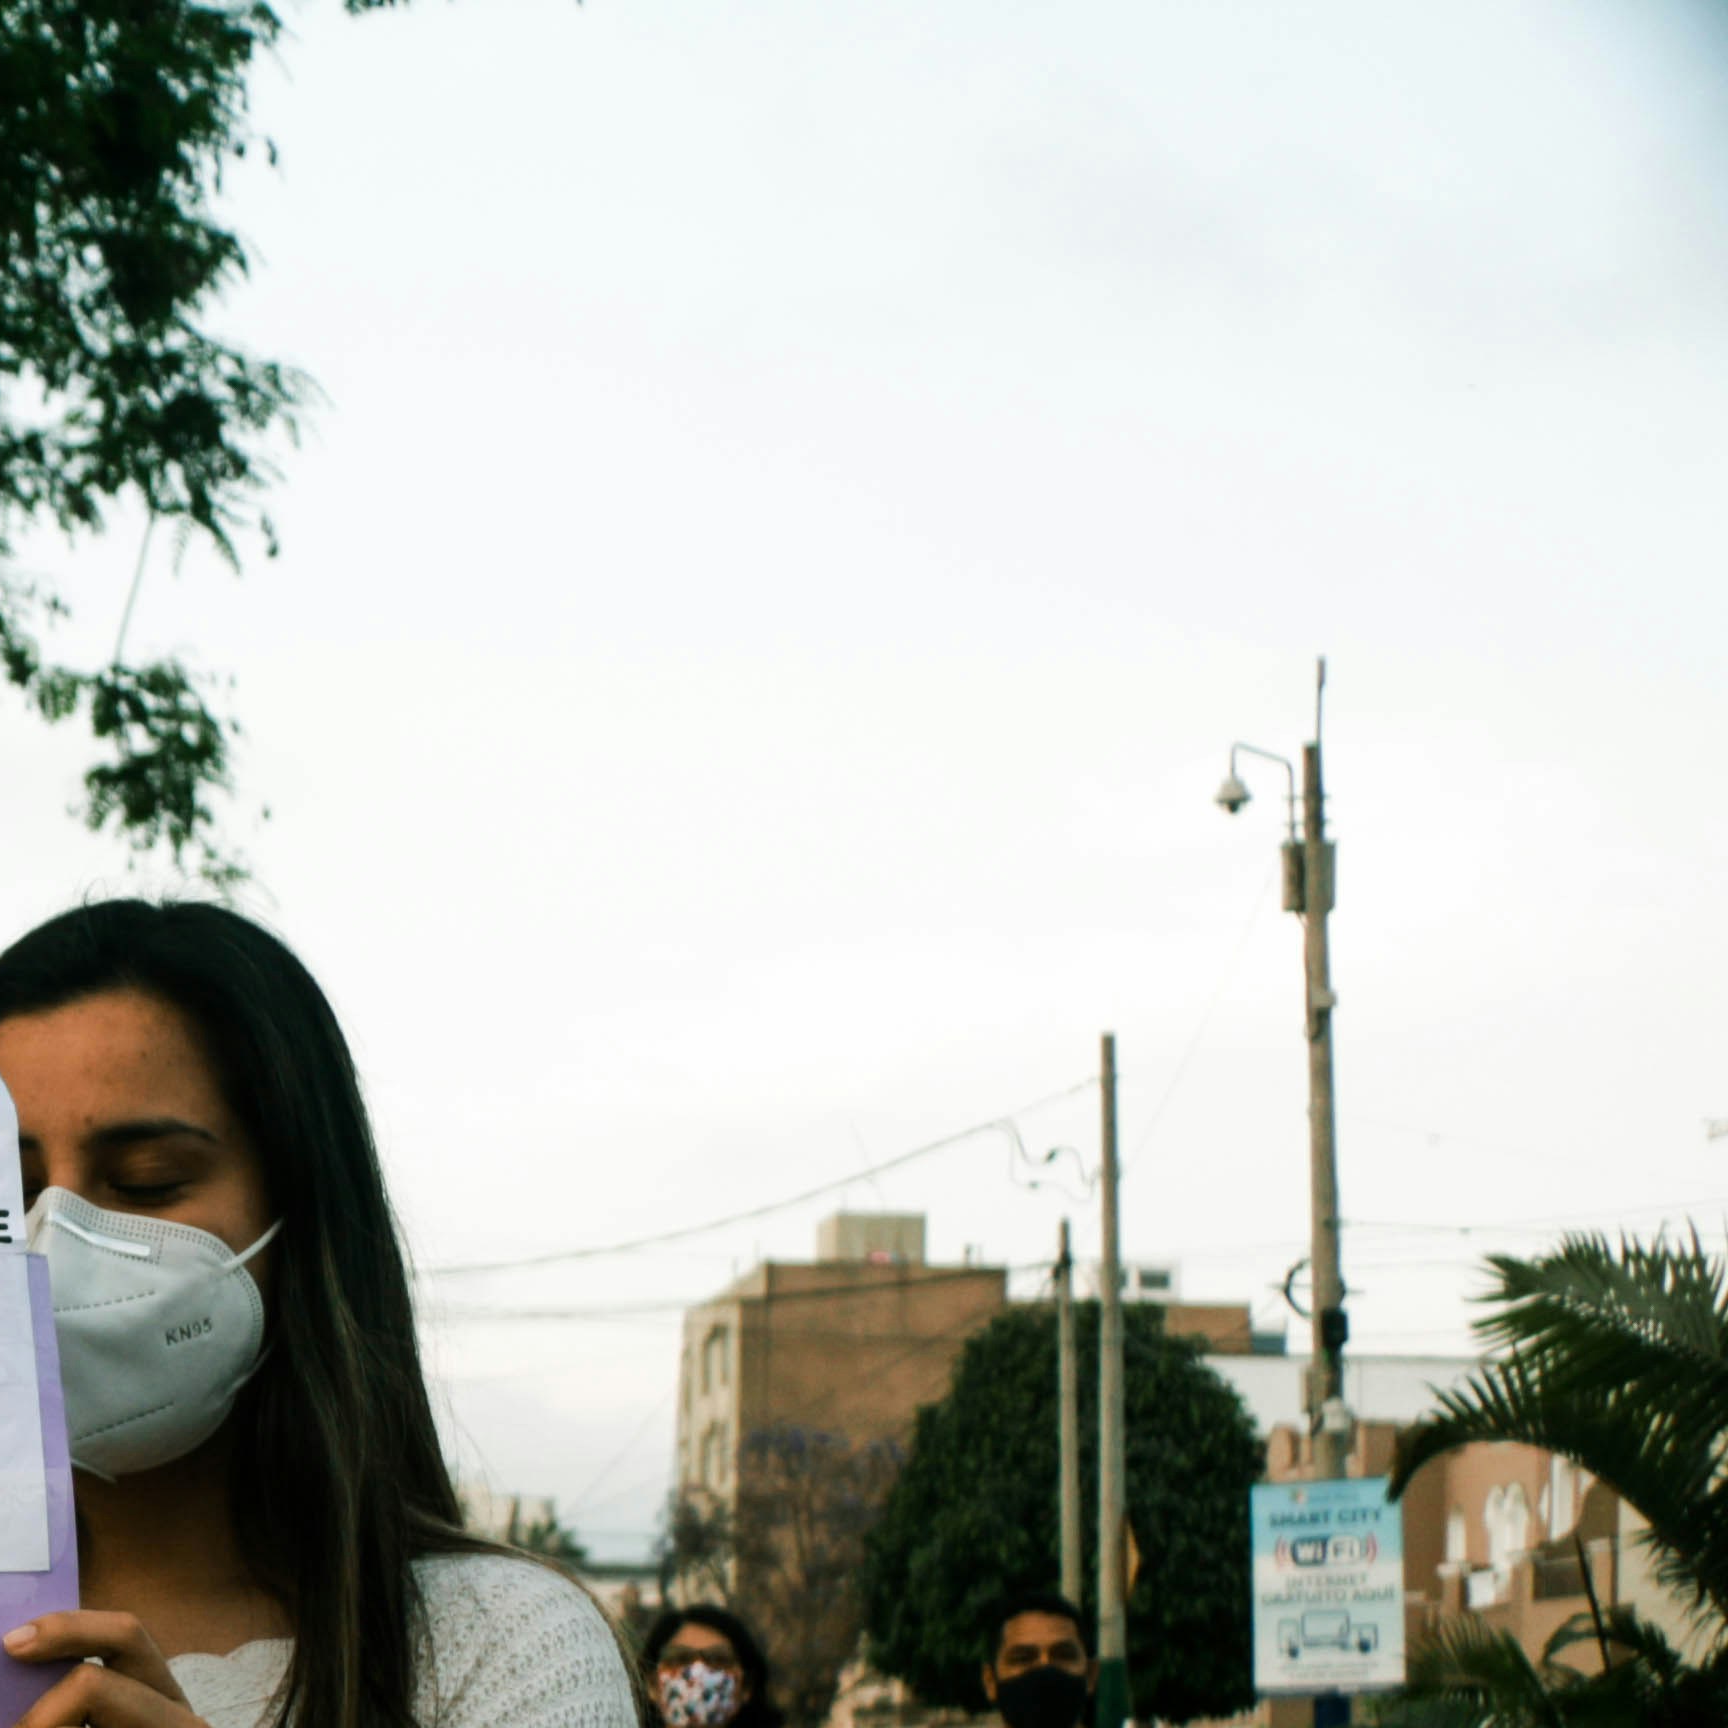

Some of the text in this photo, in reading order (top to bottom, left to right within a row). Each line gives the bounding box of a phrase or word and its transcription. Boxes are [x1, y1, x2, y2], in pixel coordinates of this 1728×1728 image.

[165, 1318, 213, 1346] KN95
[1269, 1506, 1382, 1528] SMART CITY
[1286, 1573, 1367, 1589] INTERNET
[1262, 1589, 1345, 1606] GRATUITO
